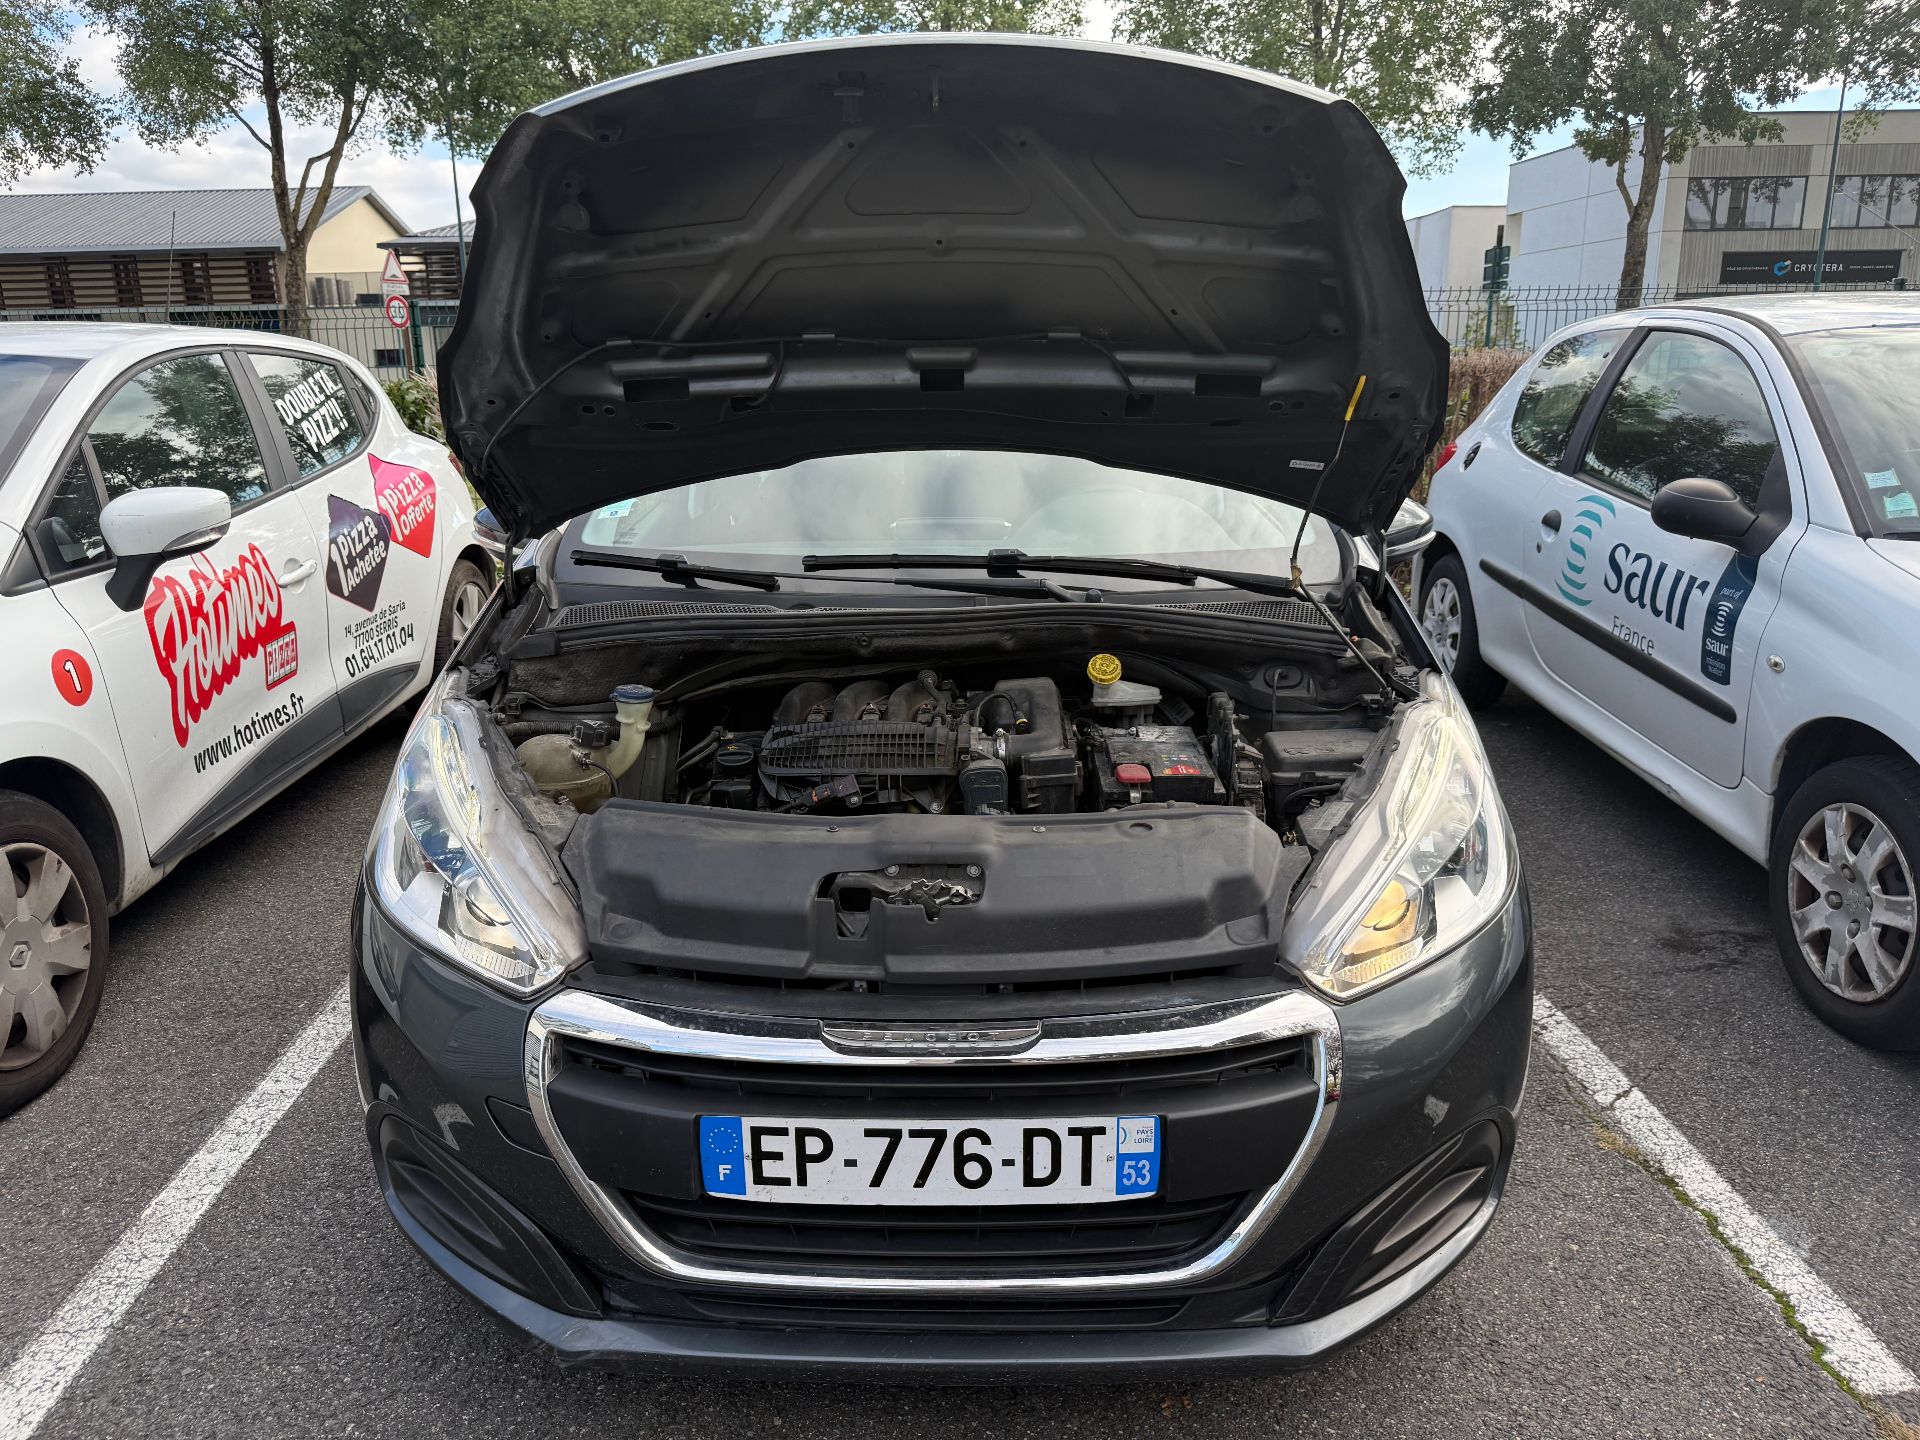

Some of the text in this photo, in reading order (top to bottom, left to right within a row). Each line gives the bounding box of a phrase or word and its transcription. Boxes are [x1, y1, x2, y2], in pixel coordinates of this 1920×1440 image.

[275, 369, 338, 426] DOUBLE TA
[383, 472, 425, 515] Pizza
[400, 493, 435, 536] Offerte
[336, 515, 379, 565] Pizza
[346, 538, 387, 592] Achetée
[1603, 542, 1711, 631] saur
[1720, 587, 1745, 600] part of
[353, 615, 399, 650] 77700 SERRIS
[354, 613, 378, 633] avenue
[379, 607, 388, 620] de
[388, 599, 406, 617] Saria
[1611, 615, 1655, 656] France
[152, 550, 280, 730] Hotimes
[344, 622, 415, 679] 01.64.17.01.04
[1705, 637, 1729, 657] saur
[62, 658, 83, 694] 1
[193, 692, 305, 774] www.hotimes.fr
[1136, 1128, 1154, 1136] PAYS
[718, 1164, 732, 1181] F
[749, 1125, 1107, 1190] EP-776-DT
[1122, 1159, 1151, 1186] 53
